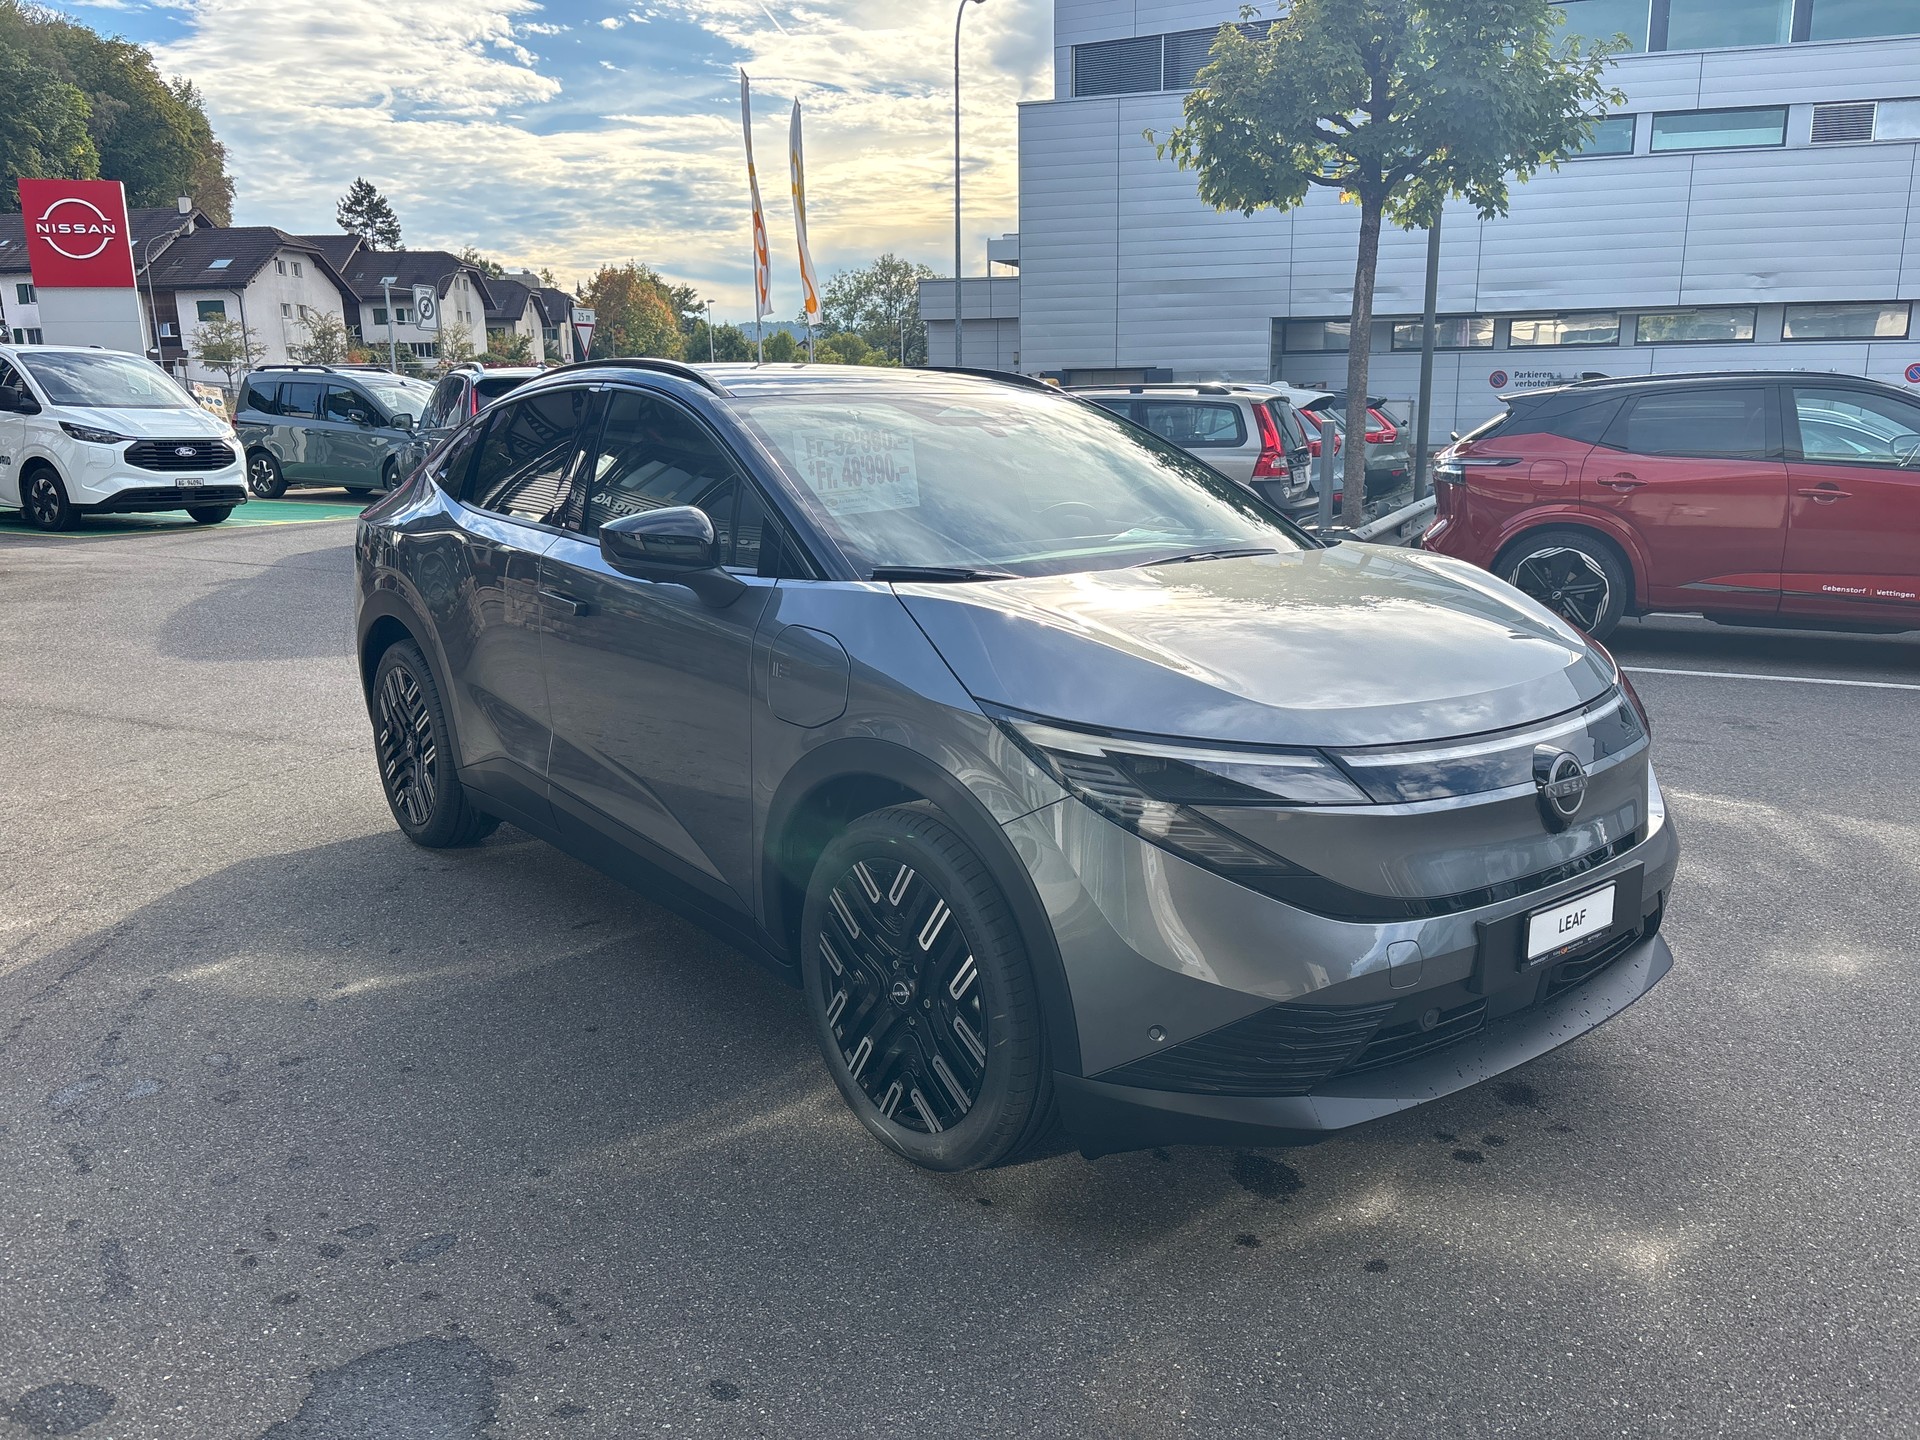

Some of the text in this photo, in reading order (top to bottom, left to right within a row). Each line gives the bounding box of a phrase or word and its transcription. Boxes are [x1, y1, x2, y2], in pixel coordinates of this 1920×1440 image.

[35, 223, 116, 234] NISSAN
[577, 312, 585, 322] 25
[1514, 370, 1552, 379] Parkieren
[1822, 584, 1916, 599] Gebenstorf Wettingen
[1547, 778, 1588, 796] NISSAN
[1558, 908, 1587, 934] LEAF
